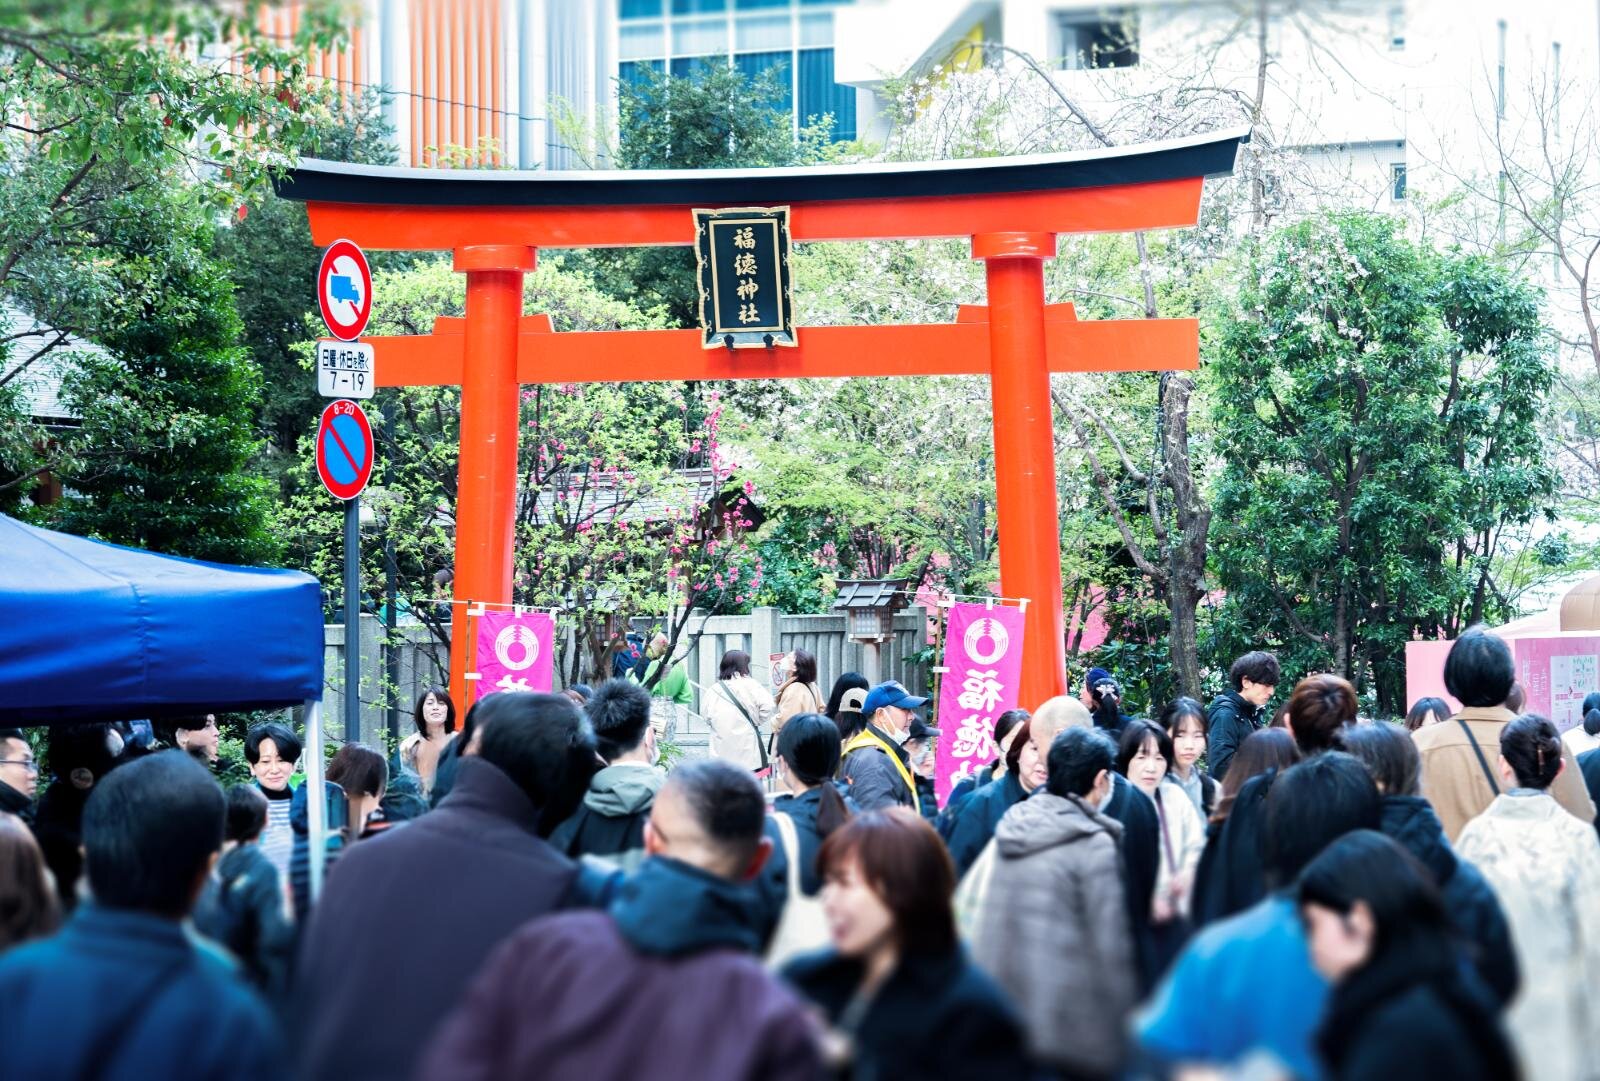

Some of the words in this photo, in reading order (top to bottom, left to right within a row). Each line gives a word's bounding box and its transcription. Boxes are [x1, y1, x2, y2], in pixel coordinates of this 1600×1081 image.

[733, 226, 760, 324] 福徳神社
[330, 371, 364, 391] 7-19
[333, 403, 355, 415] 8-20
